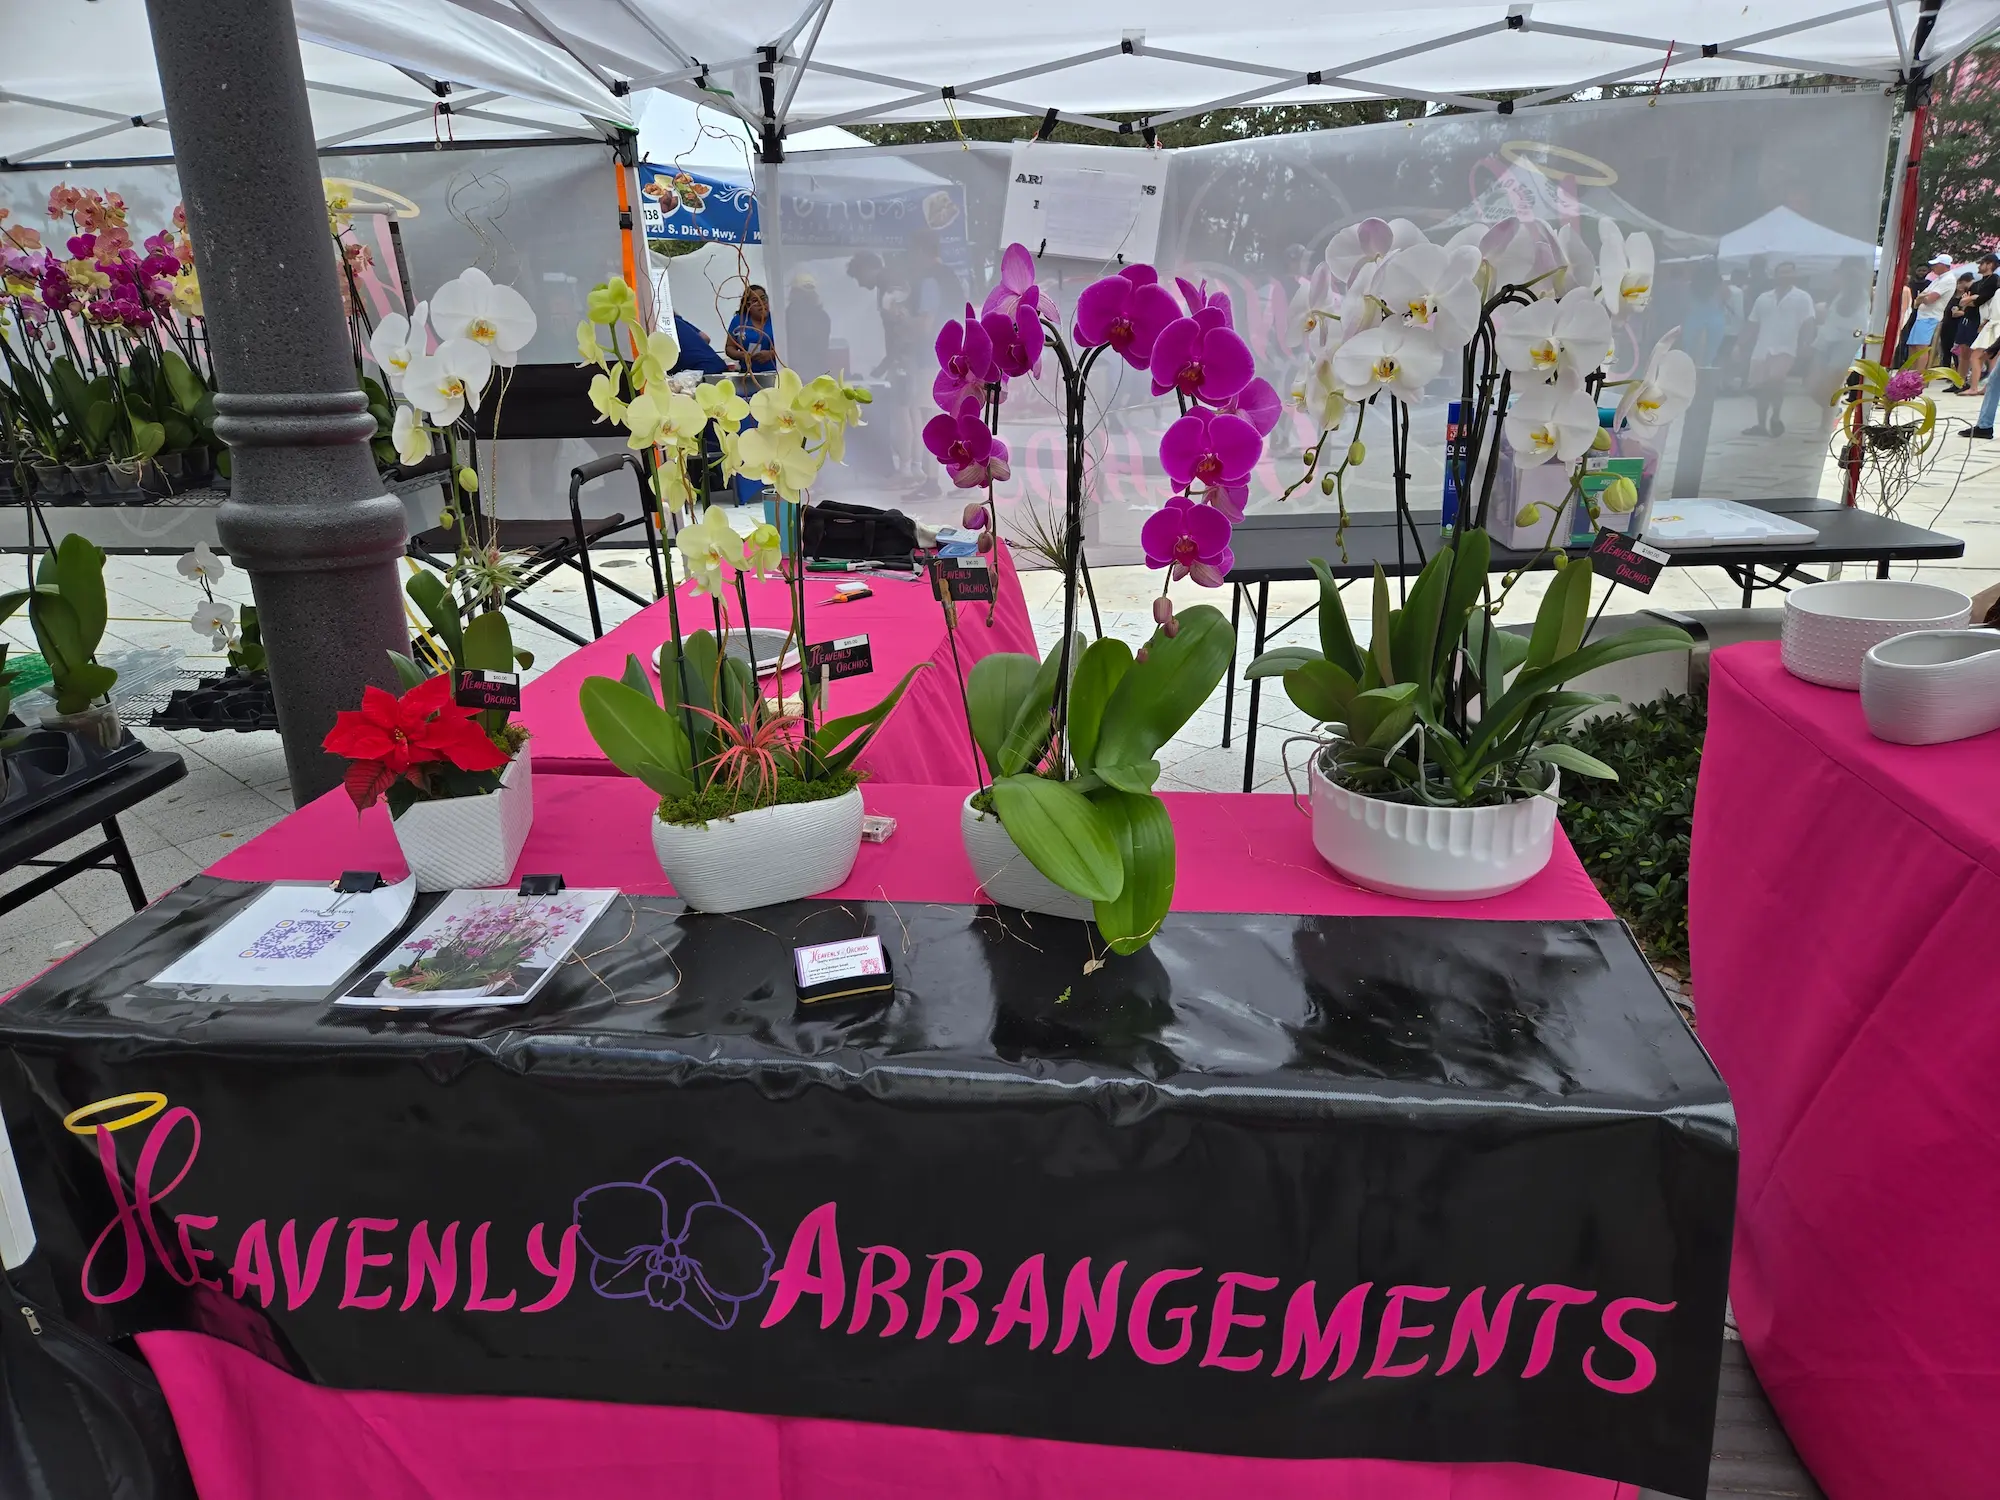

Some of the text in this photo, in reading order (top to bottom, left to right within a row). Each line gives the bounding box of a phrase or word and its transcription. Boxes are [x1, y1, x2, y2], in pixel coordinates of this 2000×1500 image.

[668, 223, 679, 234] S.
[681, 225, 709, 236] Dixie
[712, 228, 737, 239] Hwy.
[1594, 533, 1644, 565] HEAVENLY
[935, 561, 972, 584] HEAVENLY
[1616, 563, 1652, 586] ORCHIDS
[959, 582, 989, 594] ORCHIDS
[808, 645, 852, 668] HEAVENLY
[836, 658, 869, 673] ORCHIDS
[459, 671, 501, 692] HEAVENLY
[484, 693, 517, 705] ORCHIDS
[810, 945, 870, 963] HEAVENLY ORCHIDS
[80, 1106, 1678, 1395] HEAVENLY ARRANGEMENTS
